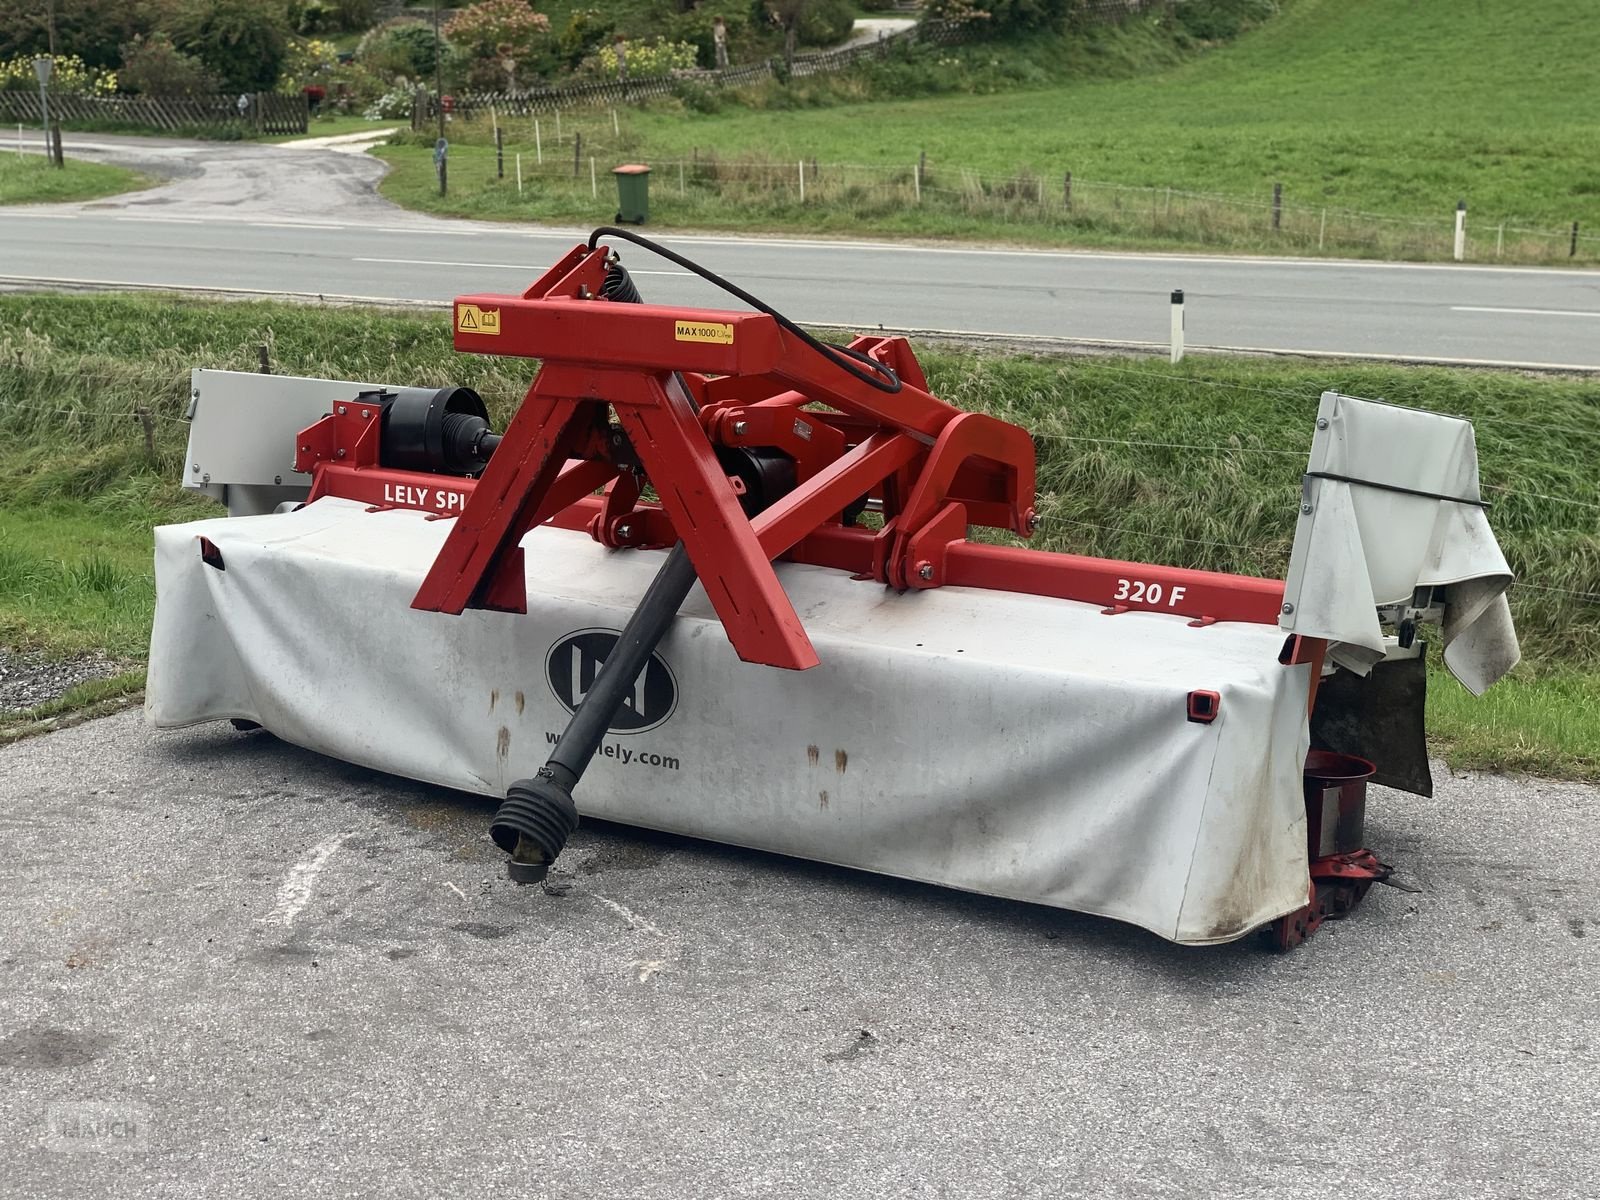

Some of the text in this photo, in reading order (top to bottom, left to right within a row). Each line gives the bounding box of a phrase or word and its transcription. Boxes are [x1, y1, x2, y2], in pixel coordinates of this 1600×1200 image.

[677, 326, 697, 336] MAX
[698, 328, 716, 338] 1000
[384, 483, 428, 506] LELY
[1113, 578, 1187, 607] 320 F
